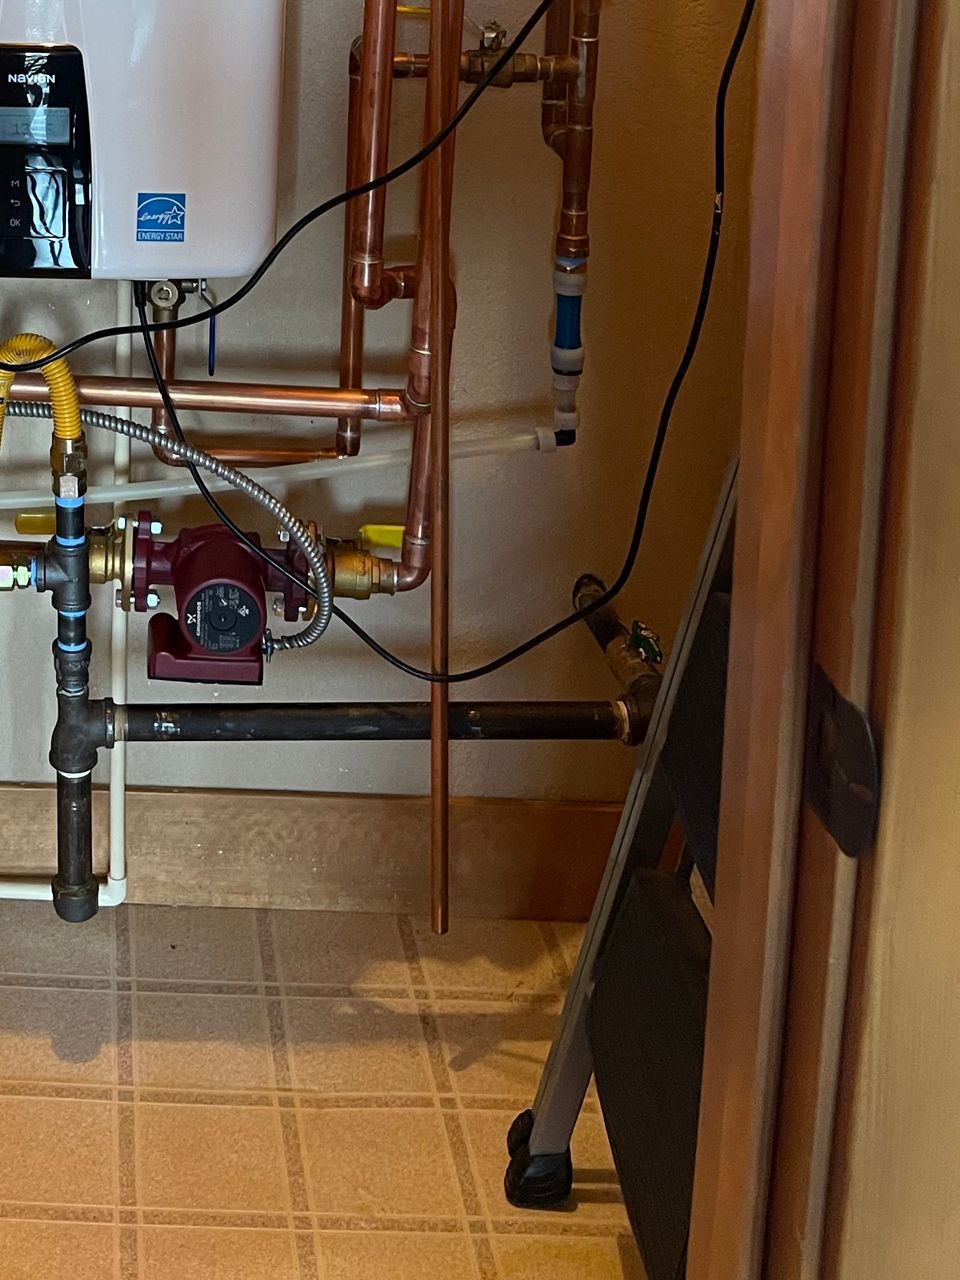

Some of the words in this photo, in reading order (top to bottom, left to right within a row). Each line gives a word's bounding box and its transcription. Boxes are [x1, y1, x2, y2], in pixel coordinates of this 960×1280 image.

[9, 218, 21, 227] OK
[138, 232, 164, 240] ENERGY
[165, 232, 183, 240] STAR
